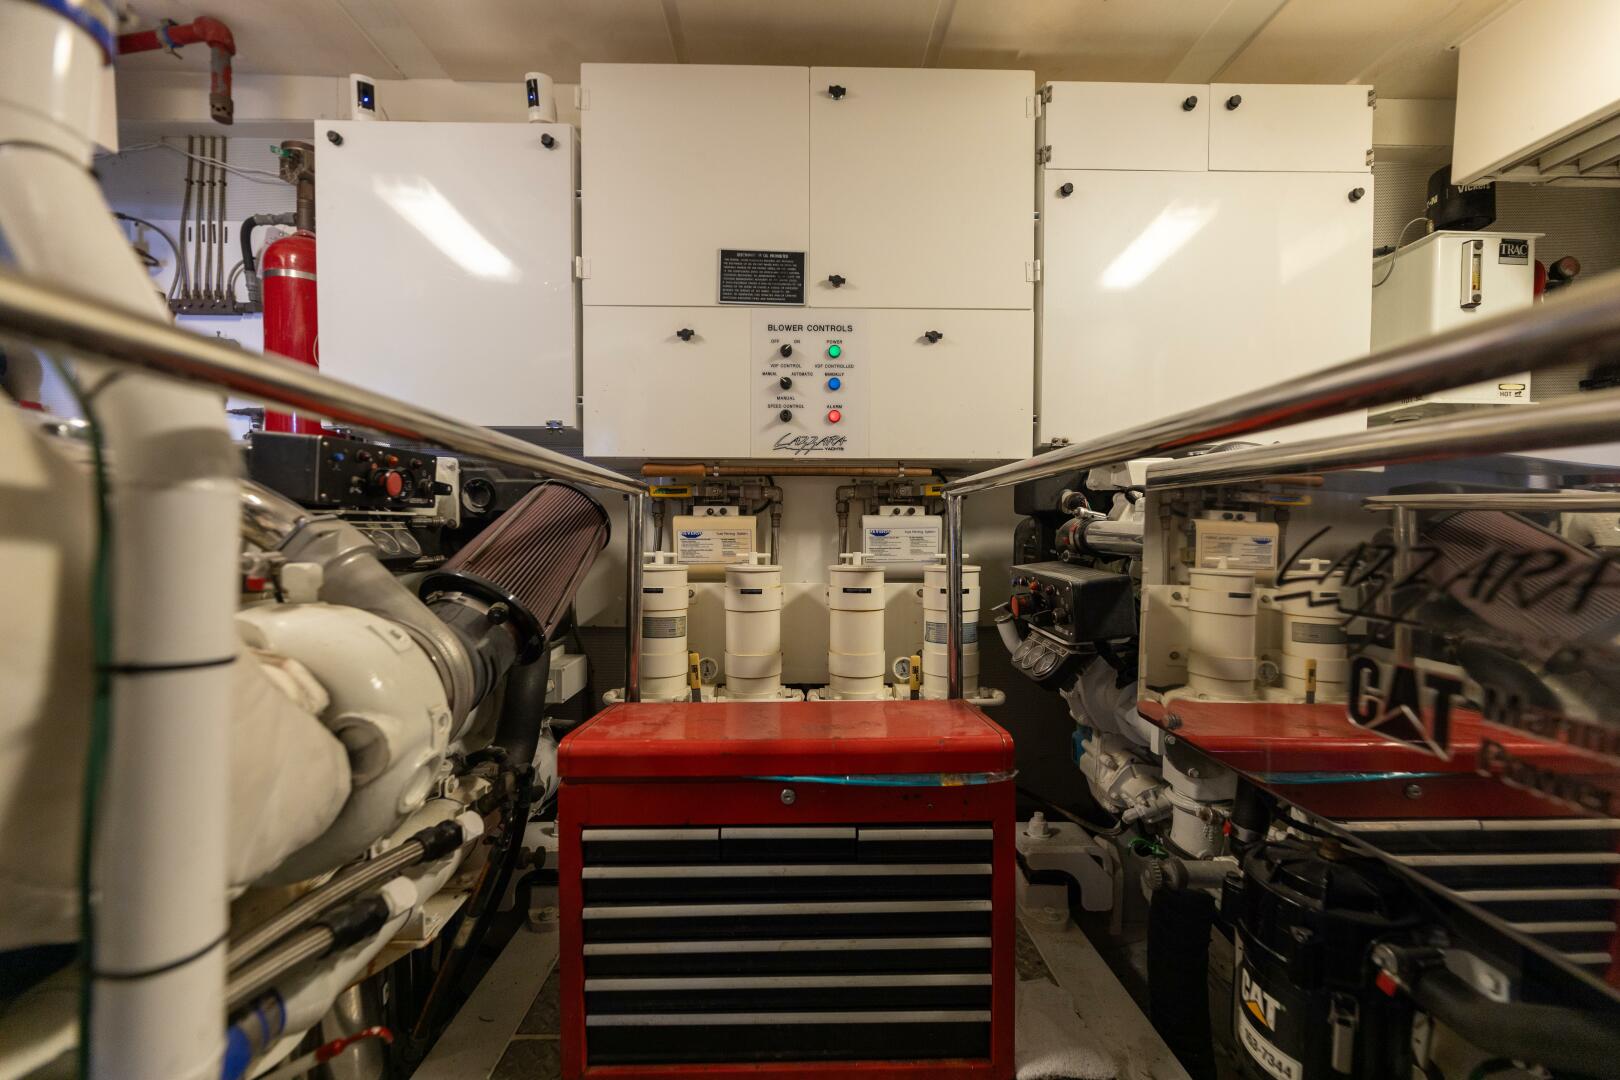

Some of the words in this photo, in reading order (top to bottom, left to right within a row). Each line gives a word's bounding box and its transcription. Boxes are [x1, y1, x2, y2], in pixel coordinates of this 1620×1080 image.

[1500, 243, 1528, 255] TRAC
[767, 324, 803, 332] BLOWER
[807, 325, 853, 333] CONTROLS
[1349, 653, 1463, 758] CAT
[1242, 968, 1281, 1033] CAT
